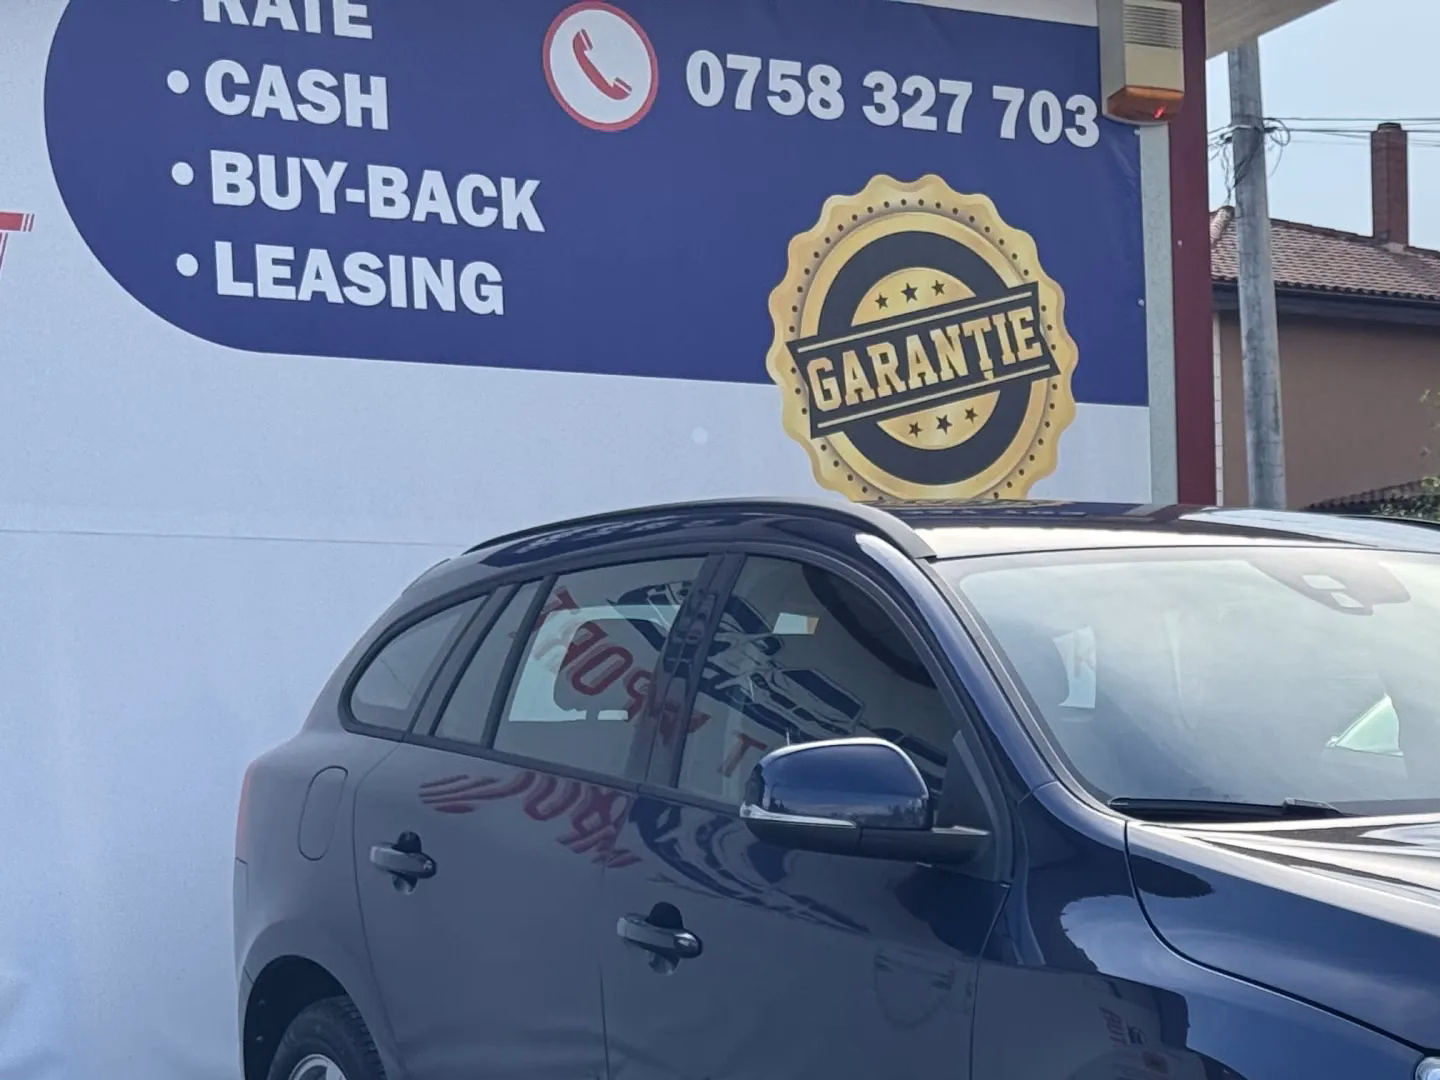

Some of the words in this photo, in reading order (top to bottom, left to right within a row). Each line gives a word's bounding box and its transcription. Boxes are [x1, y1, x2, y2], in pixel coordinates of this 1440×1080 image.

[205, 59, 389, 130] CASH
[685, 50, 846, 120] 0758
[862, 71, 972, 133] 327
[992, 86, 1100, 148] 703
[210, 149, 545, 232] BUY-BACK
[214, 241, 504, 315] LEASING
